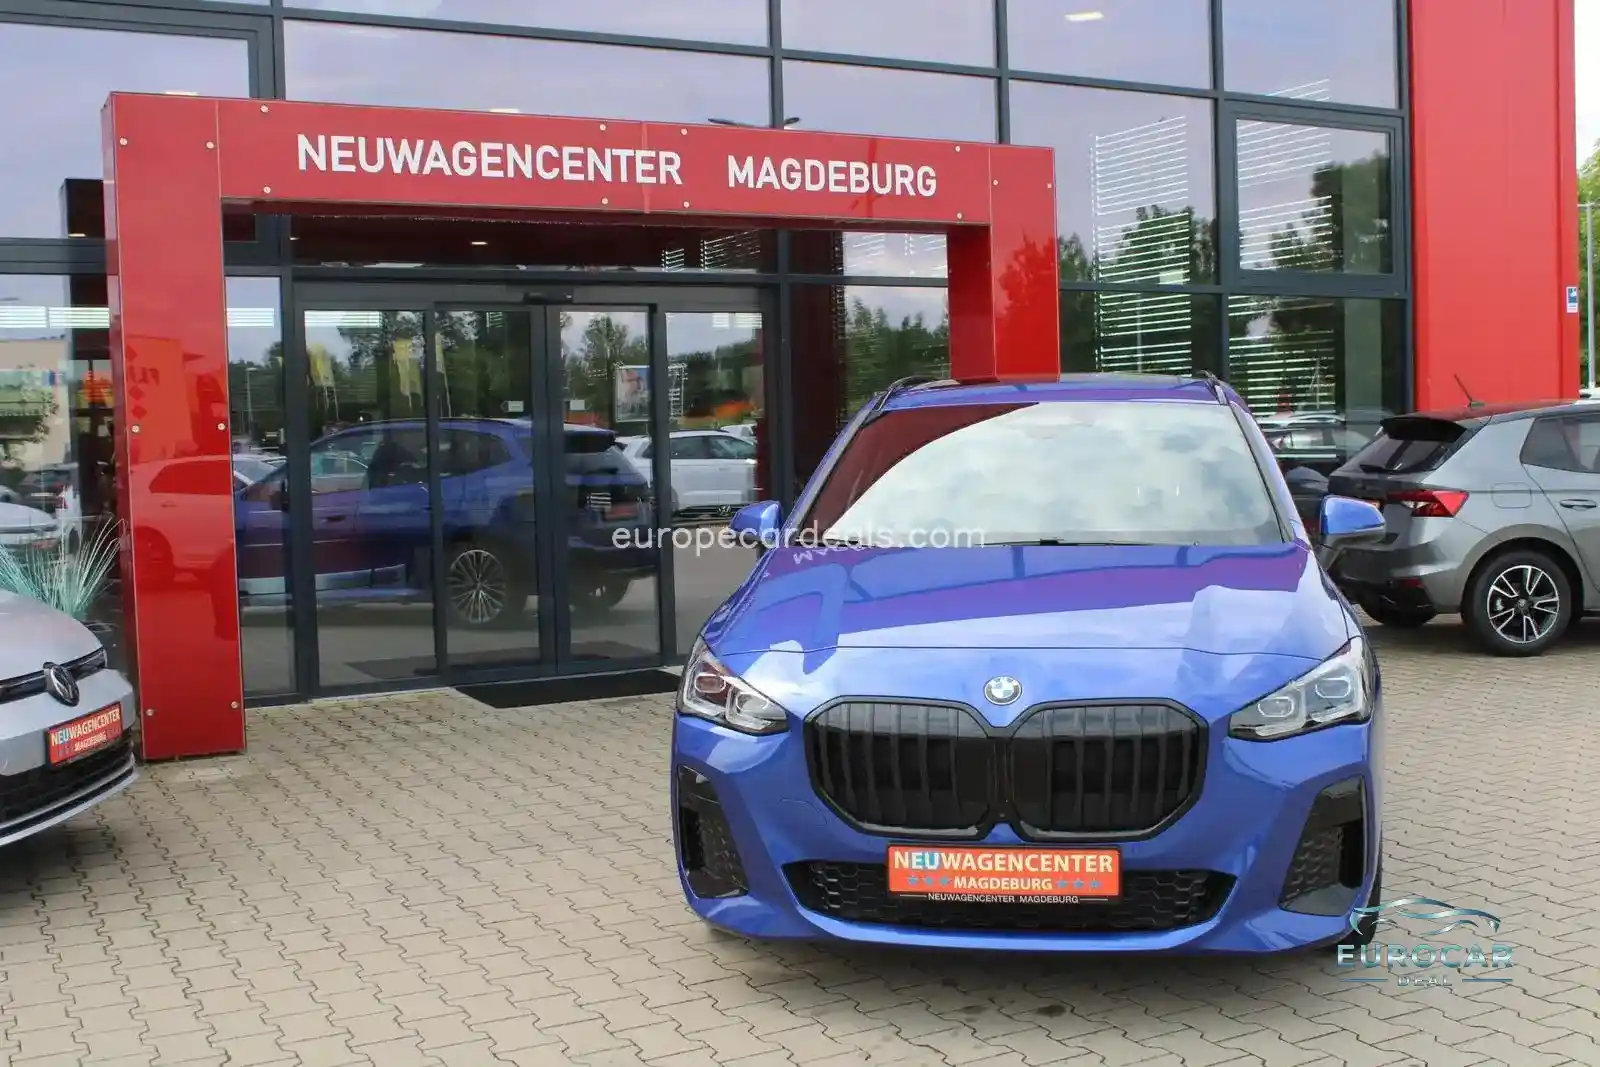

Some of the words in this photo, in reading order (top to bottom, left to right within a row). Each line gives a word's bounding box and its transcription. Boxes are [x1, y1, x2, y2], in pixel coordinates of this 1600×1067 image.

[297, 133, 683, 185] NEUWAGENCENTER
[727, 154, 937, 197] MAGDEBURG
[50, 707, 121, 747] NEUWAGENCENTER
[894, 851, 1113, 873] NEUWAGENCENTER
[953, 876, 1053, 890] MAGDEBURG
[928, 893, 1015, 903] NEUWAGENCENTER
[1019, 895, 1079, 904] MAGDEBURG
